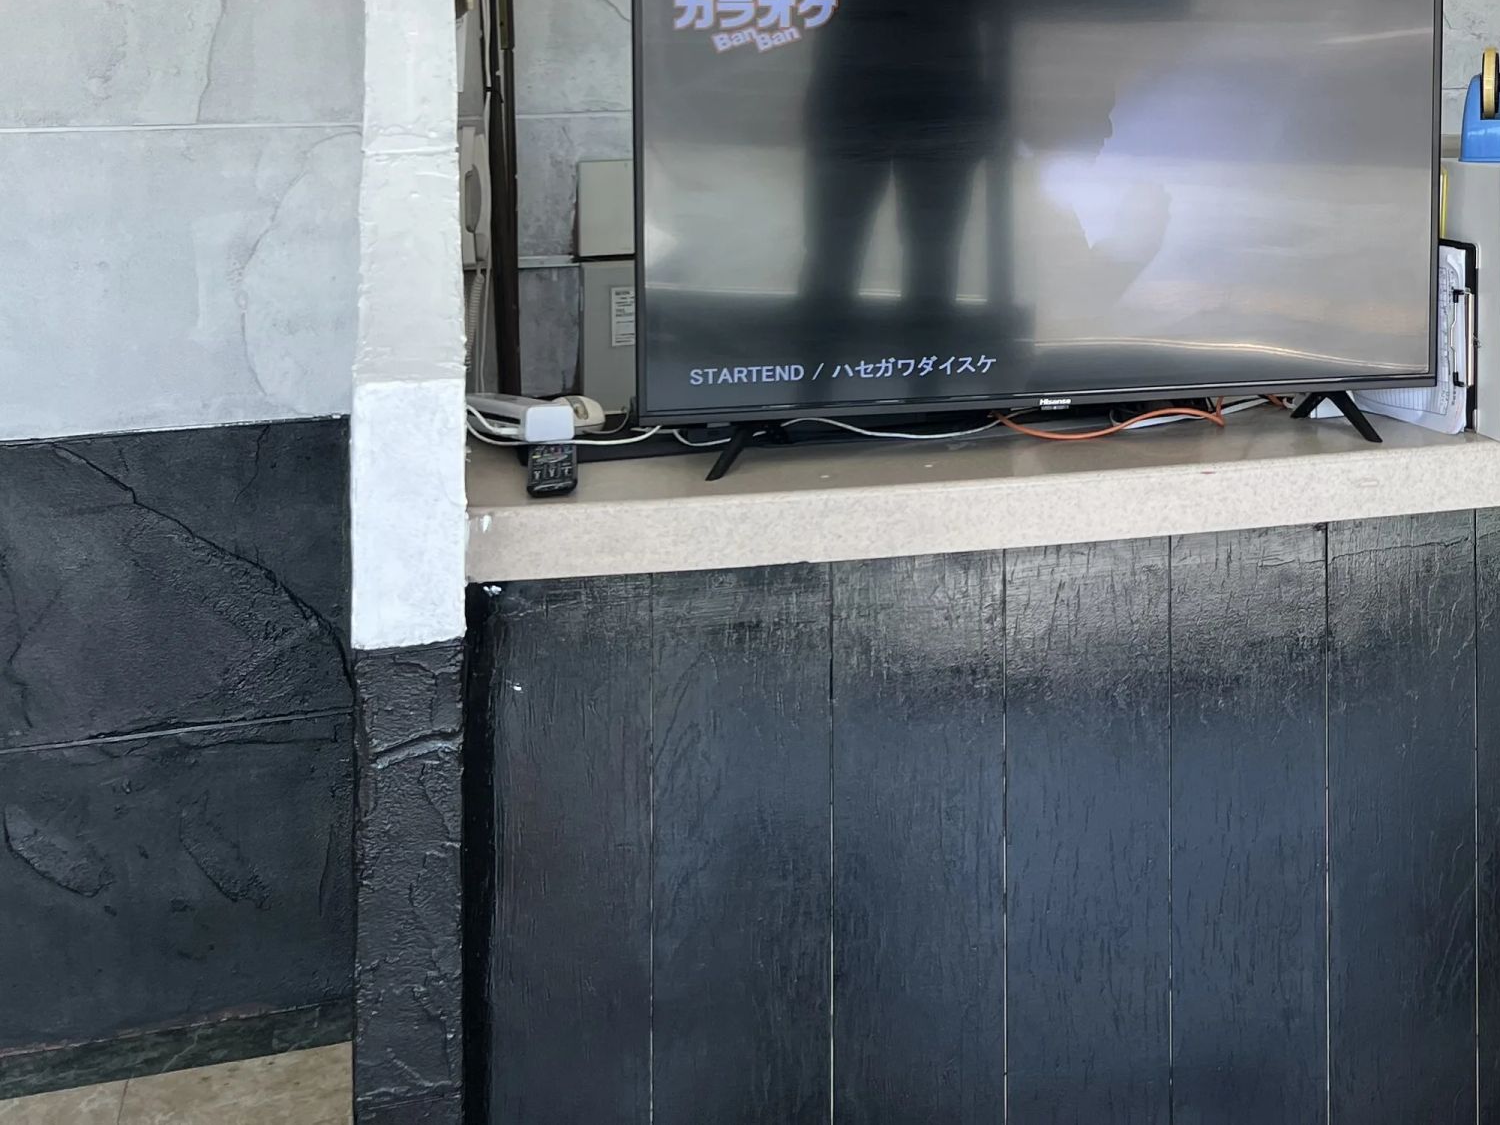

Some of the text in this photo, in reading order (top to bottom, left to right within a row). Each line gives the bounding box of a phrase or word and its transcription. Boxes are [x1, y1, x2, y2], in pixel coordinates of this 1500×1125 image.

[712, 26, 801, 53] Ban Ban
[690, 354, 997, 385] STARTEND / ハセガワダイスケ
